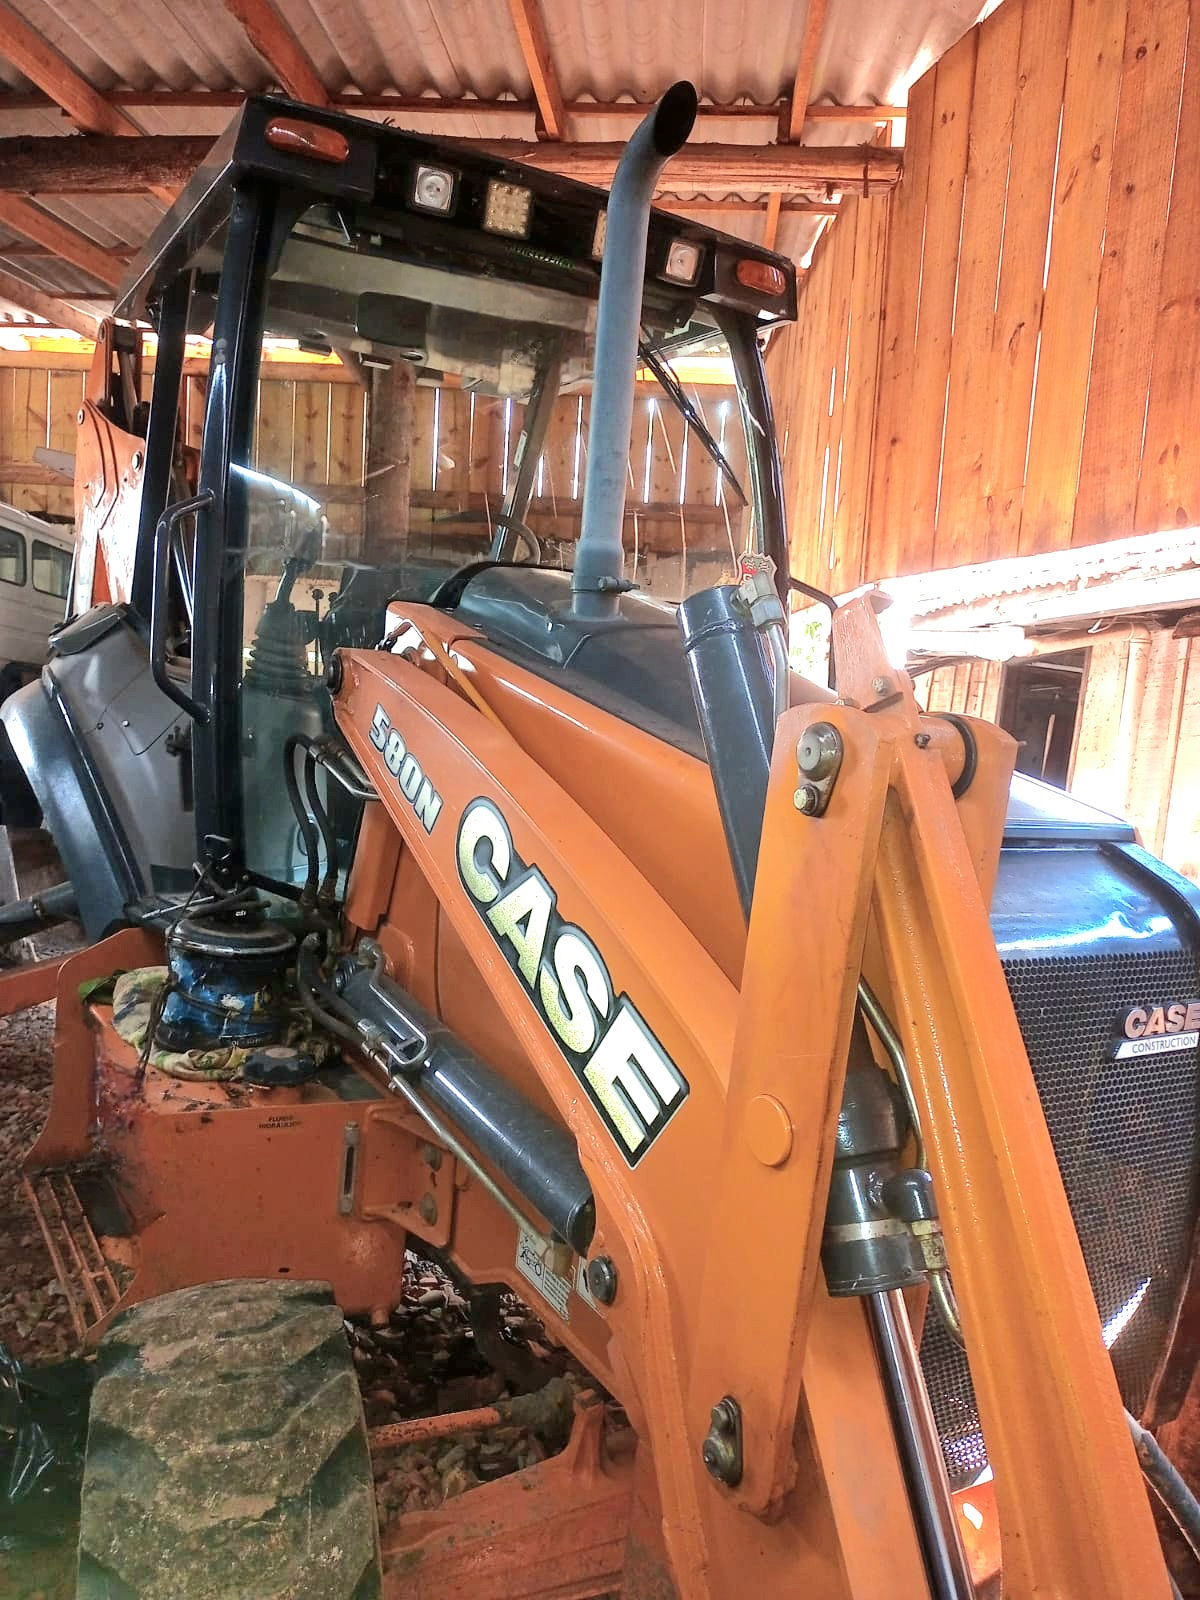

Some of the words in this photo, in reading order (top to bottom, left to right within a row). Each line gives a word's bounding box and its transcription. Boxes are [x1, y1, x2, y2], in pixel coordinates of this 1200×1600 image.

[369, 702, 443, 836] 580N
[456, 797, 688, 1165] CASE
[1124, 1002, 1200, 1040] CASE
[1132, 1035, 1196, 1054] CONSTRUCTION
